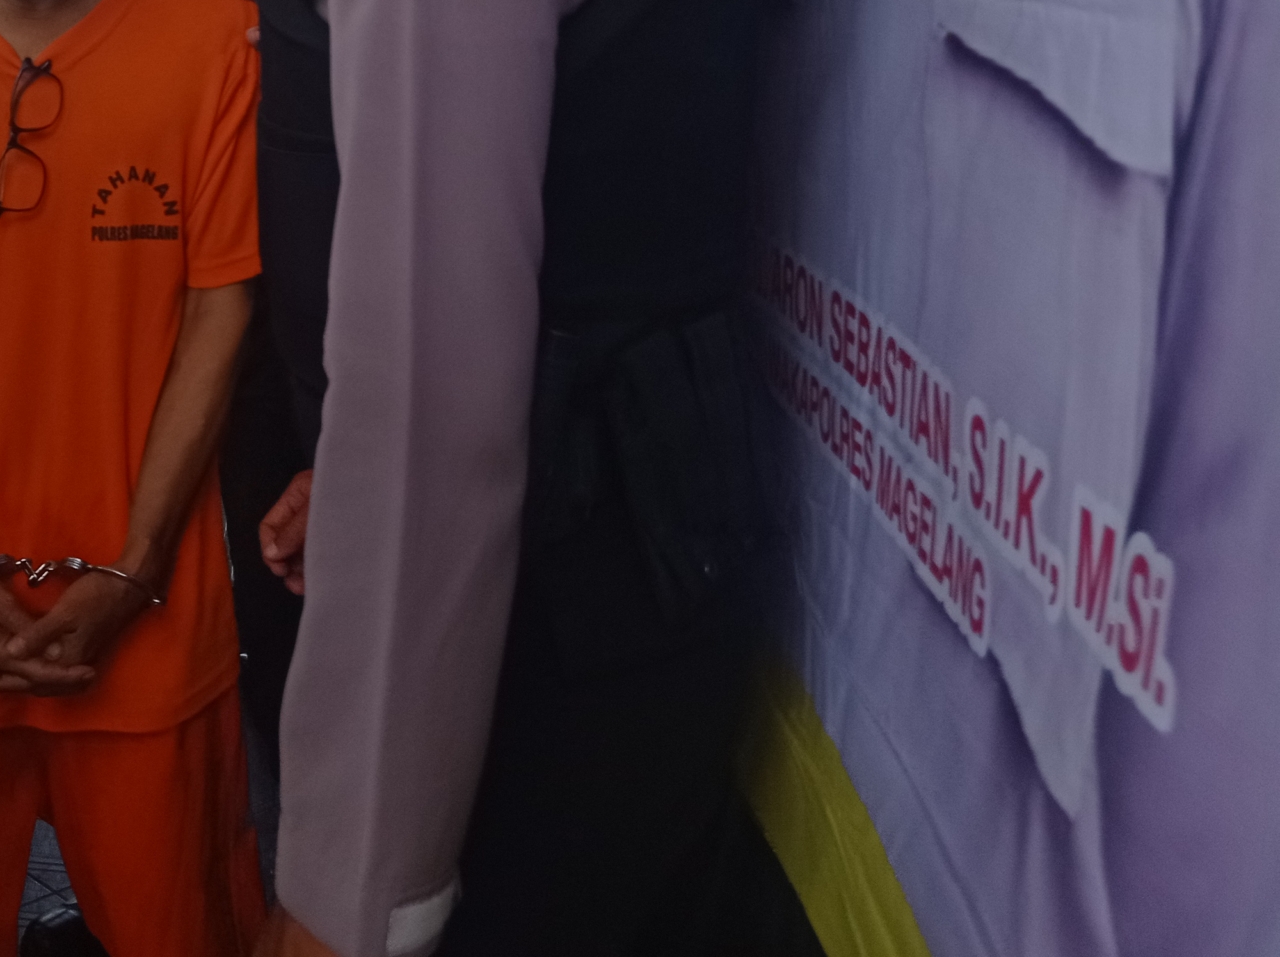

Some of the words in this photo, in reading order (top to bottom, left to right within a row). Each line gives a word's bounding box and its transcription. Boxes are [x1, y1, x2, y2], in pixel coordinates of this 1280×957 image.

[91, 165, 179, 218] TAHANAN
[91, 226, 129, 241] POLRES
[829, 290, 959, 501] SEBASTIAN,
[1074, 506, 1167, 708] M.Si.
[875, 446, 987, 635] MAGELANG
